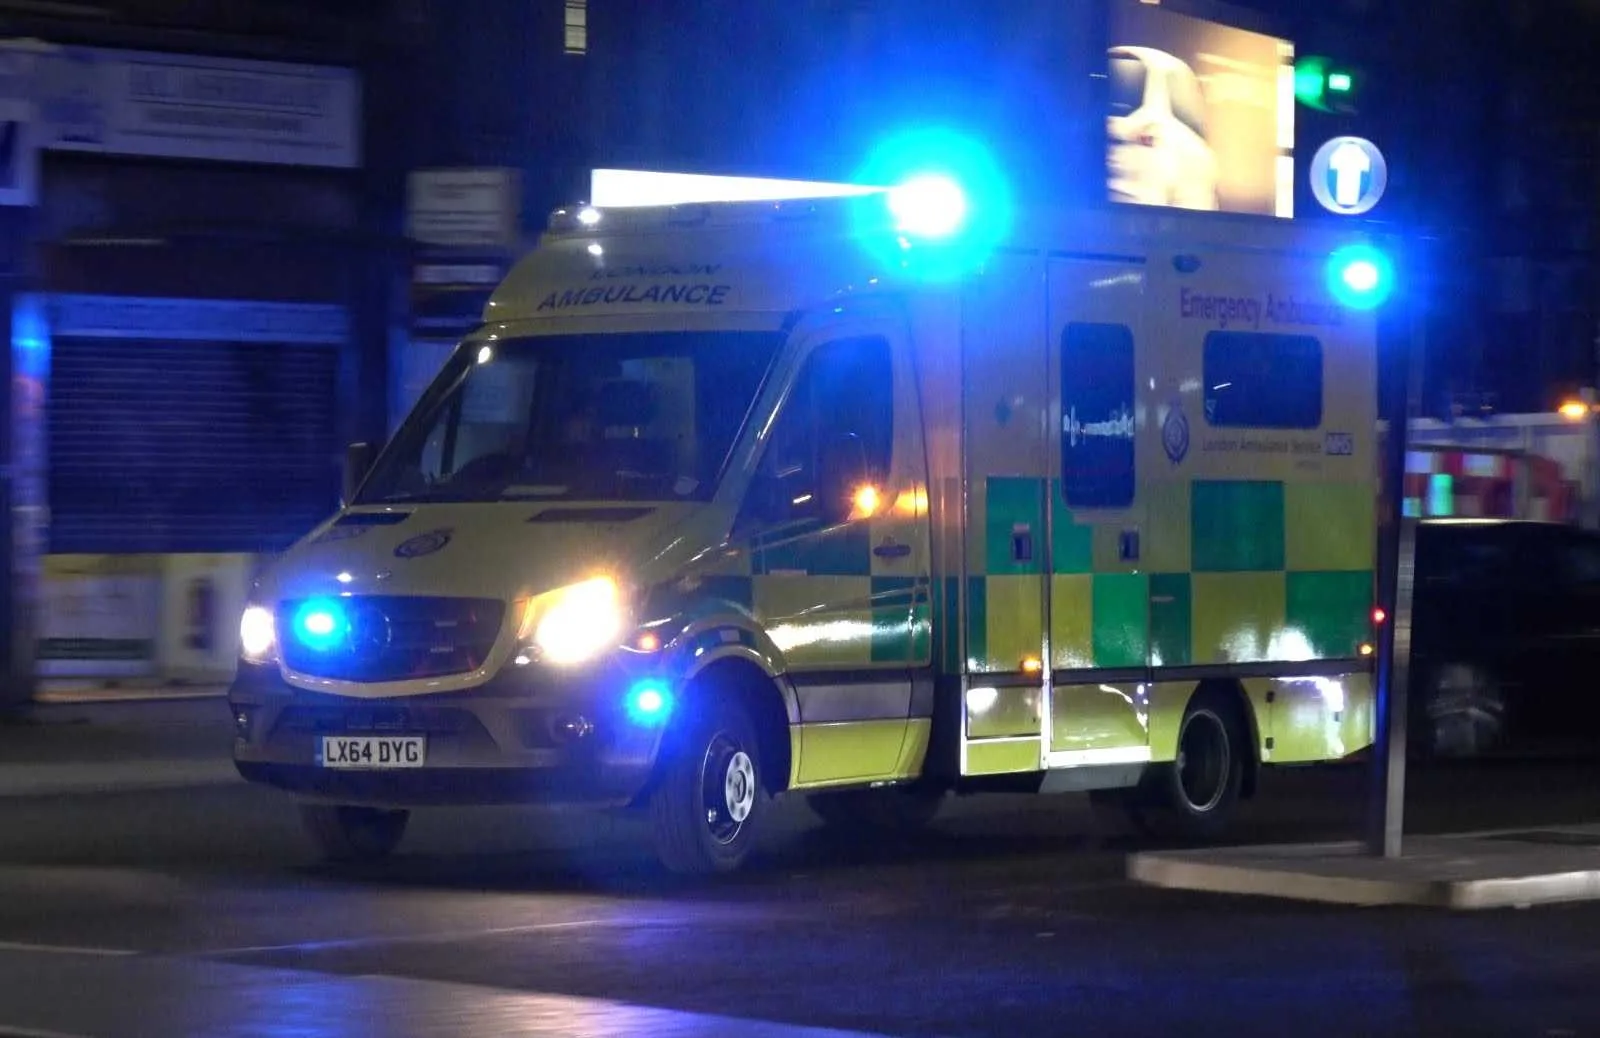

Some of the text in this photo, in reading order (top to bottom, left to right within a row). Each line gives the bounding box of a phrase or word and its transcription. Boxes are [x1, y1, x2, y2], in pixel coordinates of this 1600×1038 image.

[536, 284, 731, 312] AMBULANCE
[1180, 287, 1262, 328] Emergency
[326, 741, 418, 762] LX64 DYG
